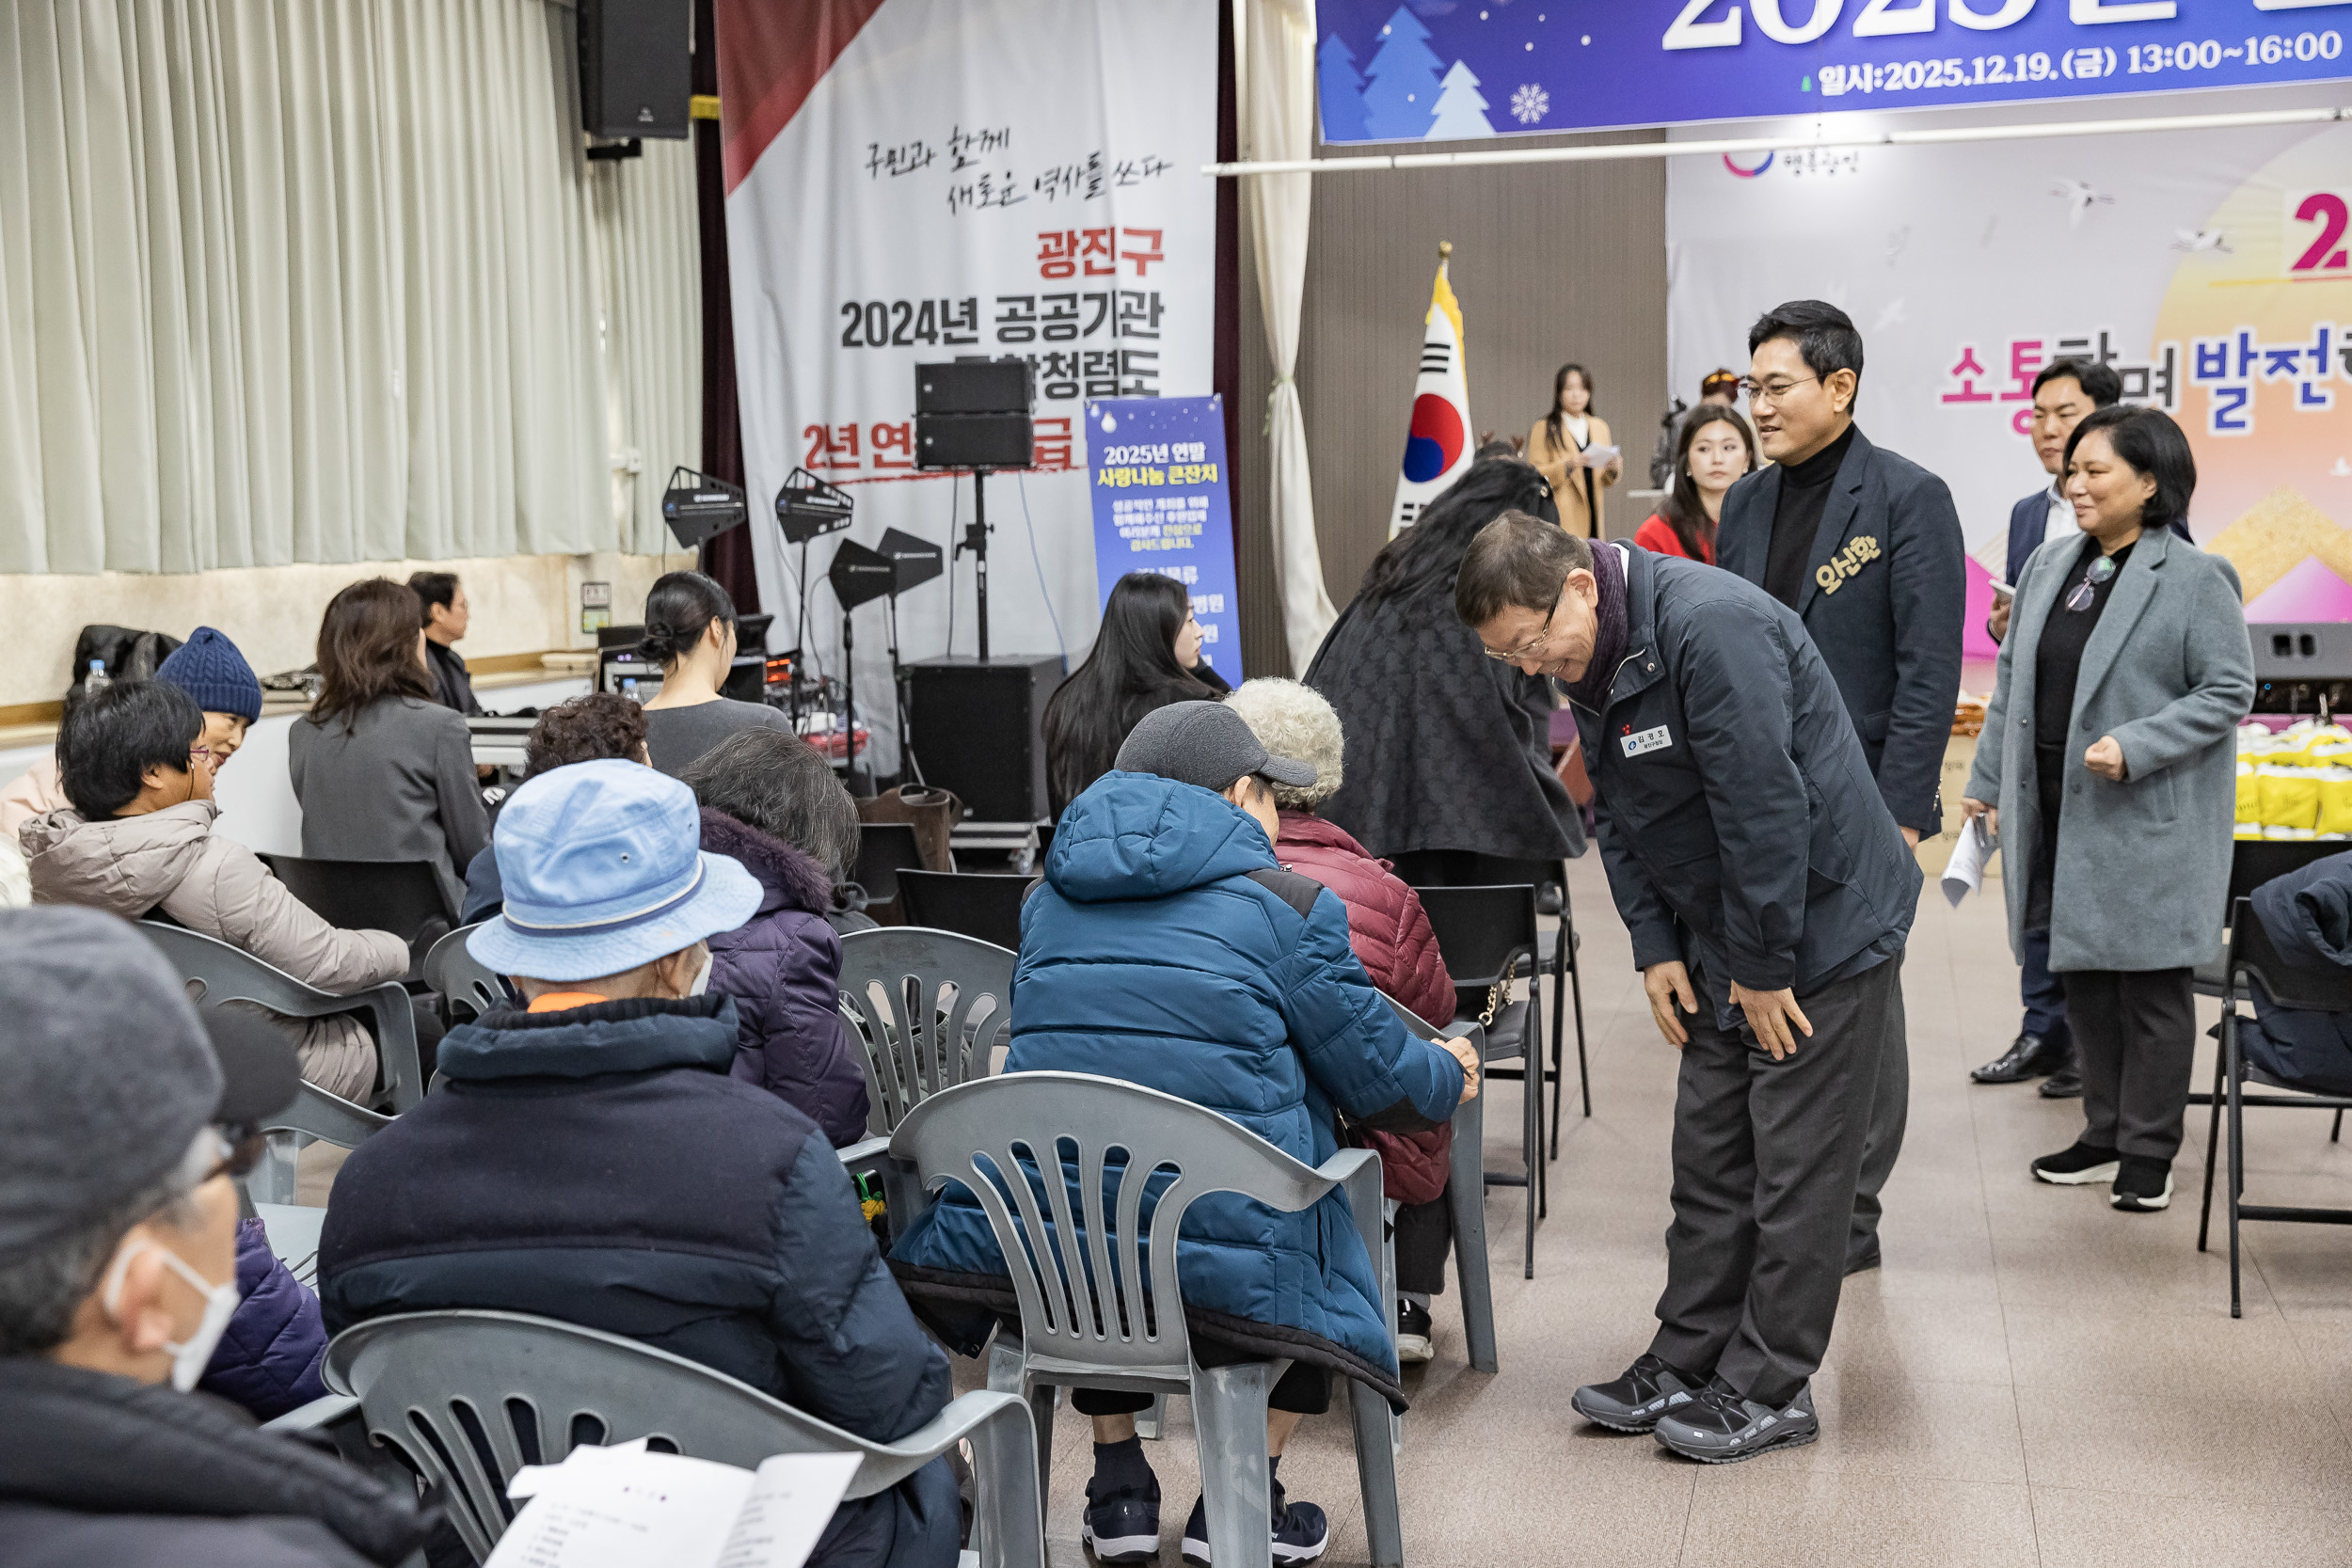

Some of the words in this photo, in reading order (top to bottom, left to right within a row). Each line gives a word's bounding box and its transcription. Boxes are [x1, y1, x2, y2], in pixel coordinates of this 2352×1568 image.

[2127, 30, 2344, 74] 13:00~16:00
[865, 140, 937, 180] 구민과
[947, 123, 1010, 172] 함께
[946, 170, 1028, 215] 새로운
[1033, 150, 1108, 202] 역사를
[1112, 153, 1174, 186] 쓰다
[1037, 226, 1164, 279] 광진구
[841, 296, 979, 348] 2024년
[994, 288, 1165, 343] 공공기관
[2197, 328, 2352, 429] 발전
[803, 422, 861, 469] 2년
[1104, 443, 1169, 466] 2025년
[1097, 466, 1166, 487] 사랑나눔
[1168, 463, 1219, 485] 큰잔치
